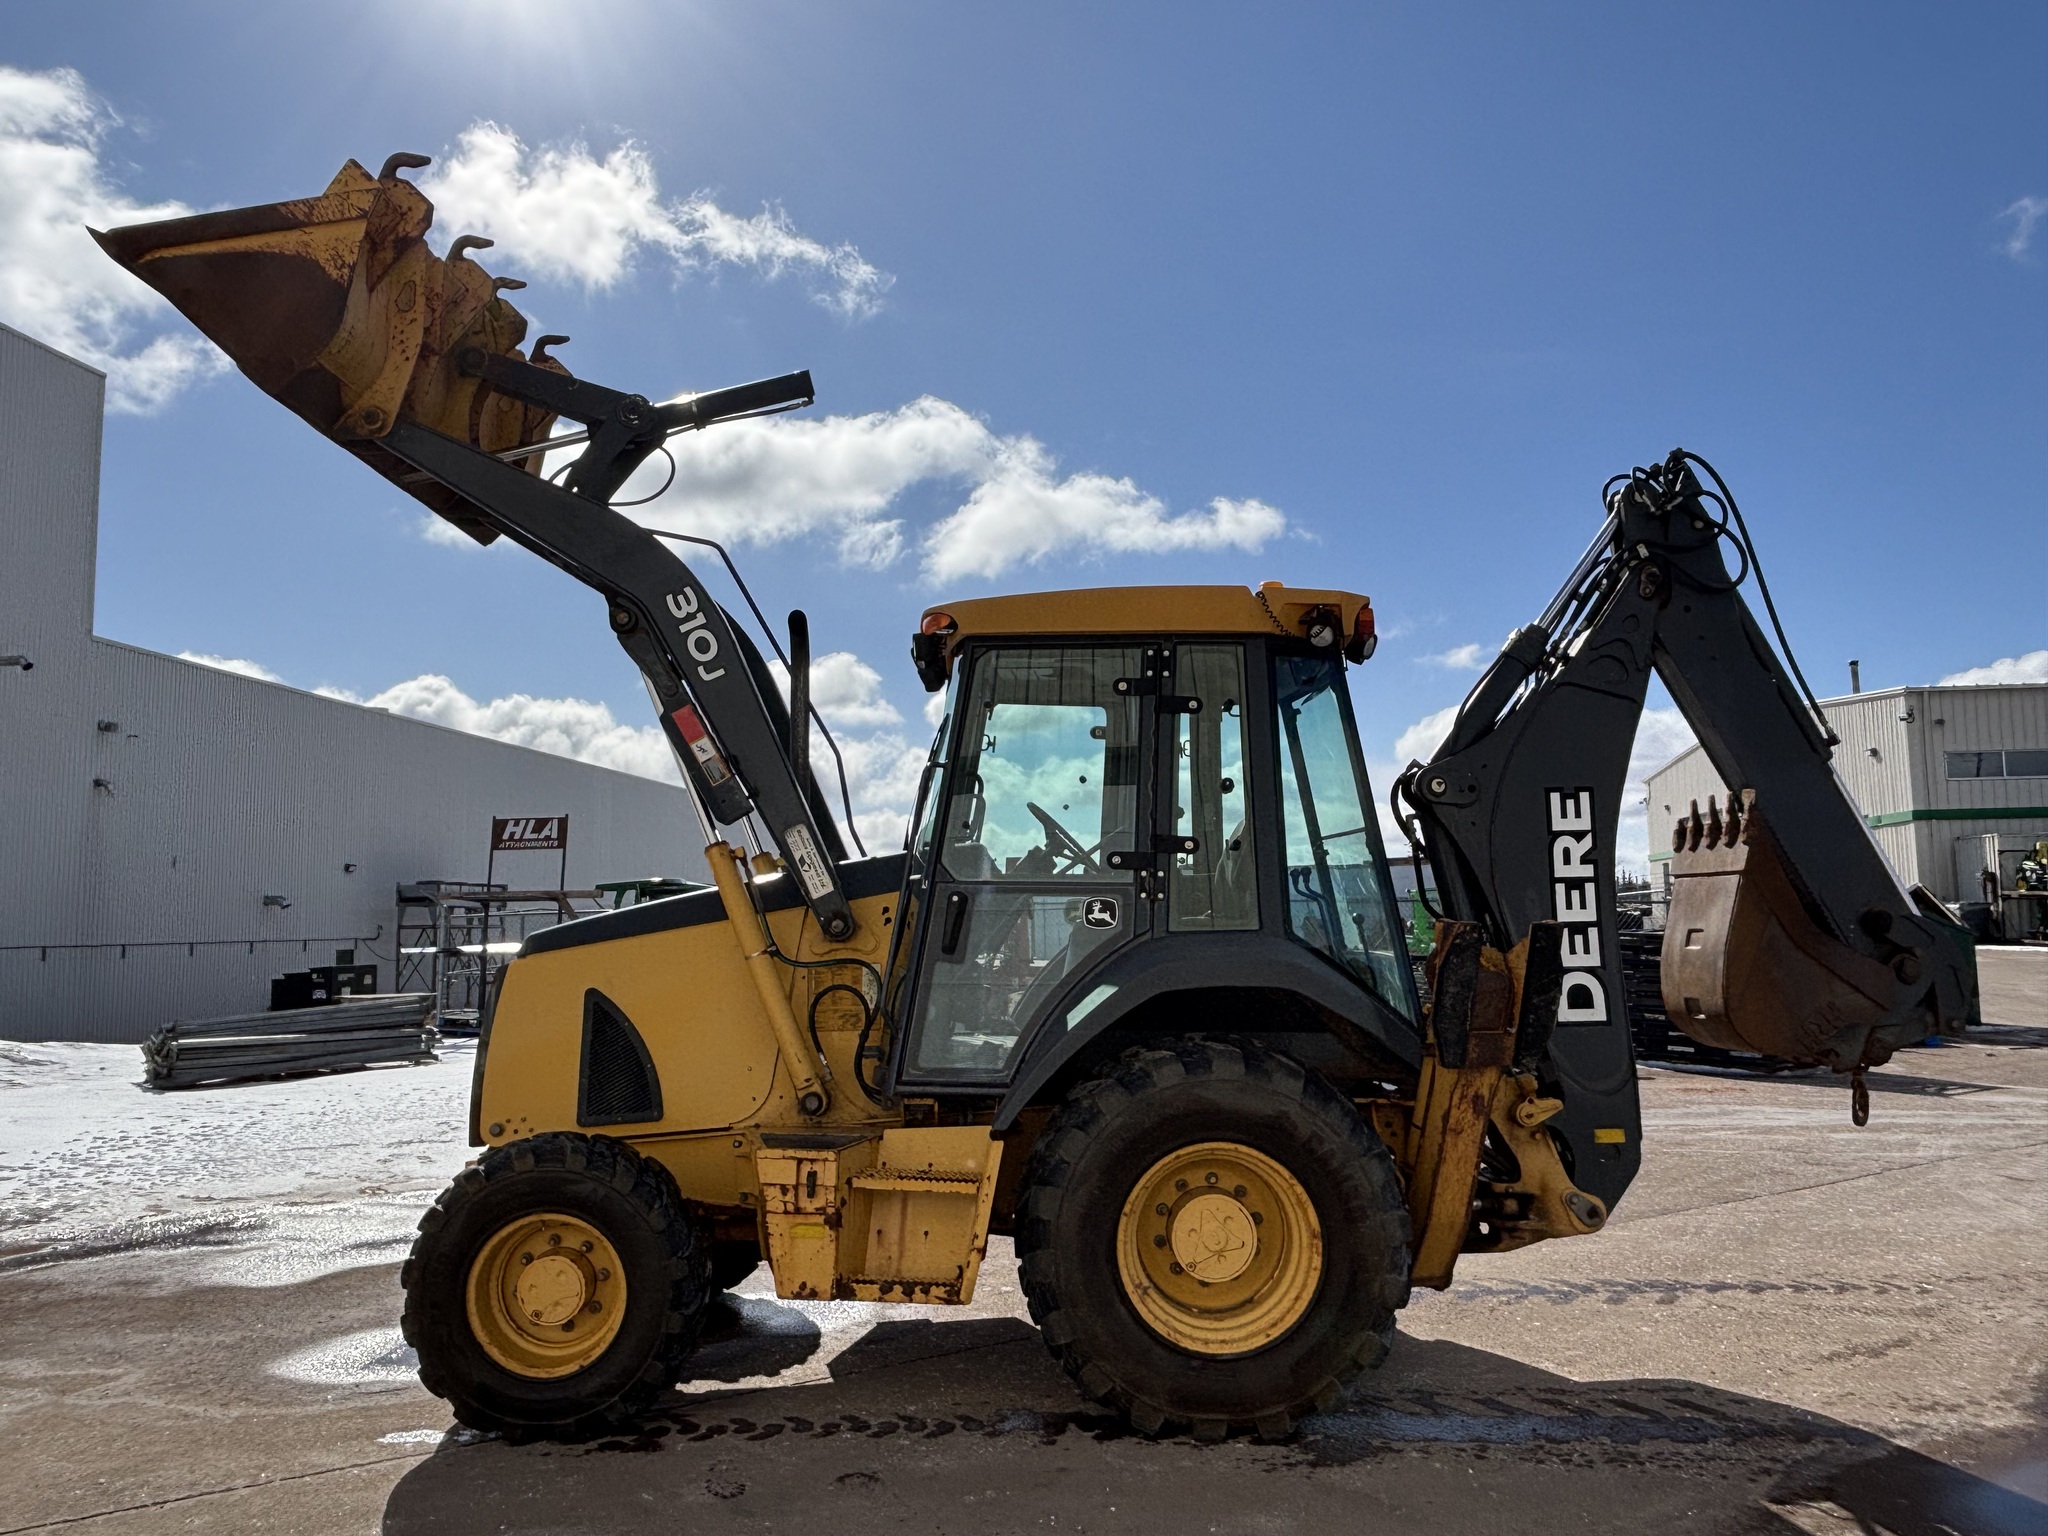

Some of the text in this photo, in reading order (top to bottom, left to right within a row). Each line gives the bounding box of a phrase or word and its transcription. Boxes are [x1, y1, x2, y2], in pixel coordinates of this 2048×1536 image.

[665, 586, 726, 682] 310J
[498, 840, 559, 849] ATTACHMENTS
[502, 819, 558, 840] HLA
[1550, 791, 1607, 1022] DEERE
